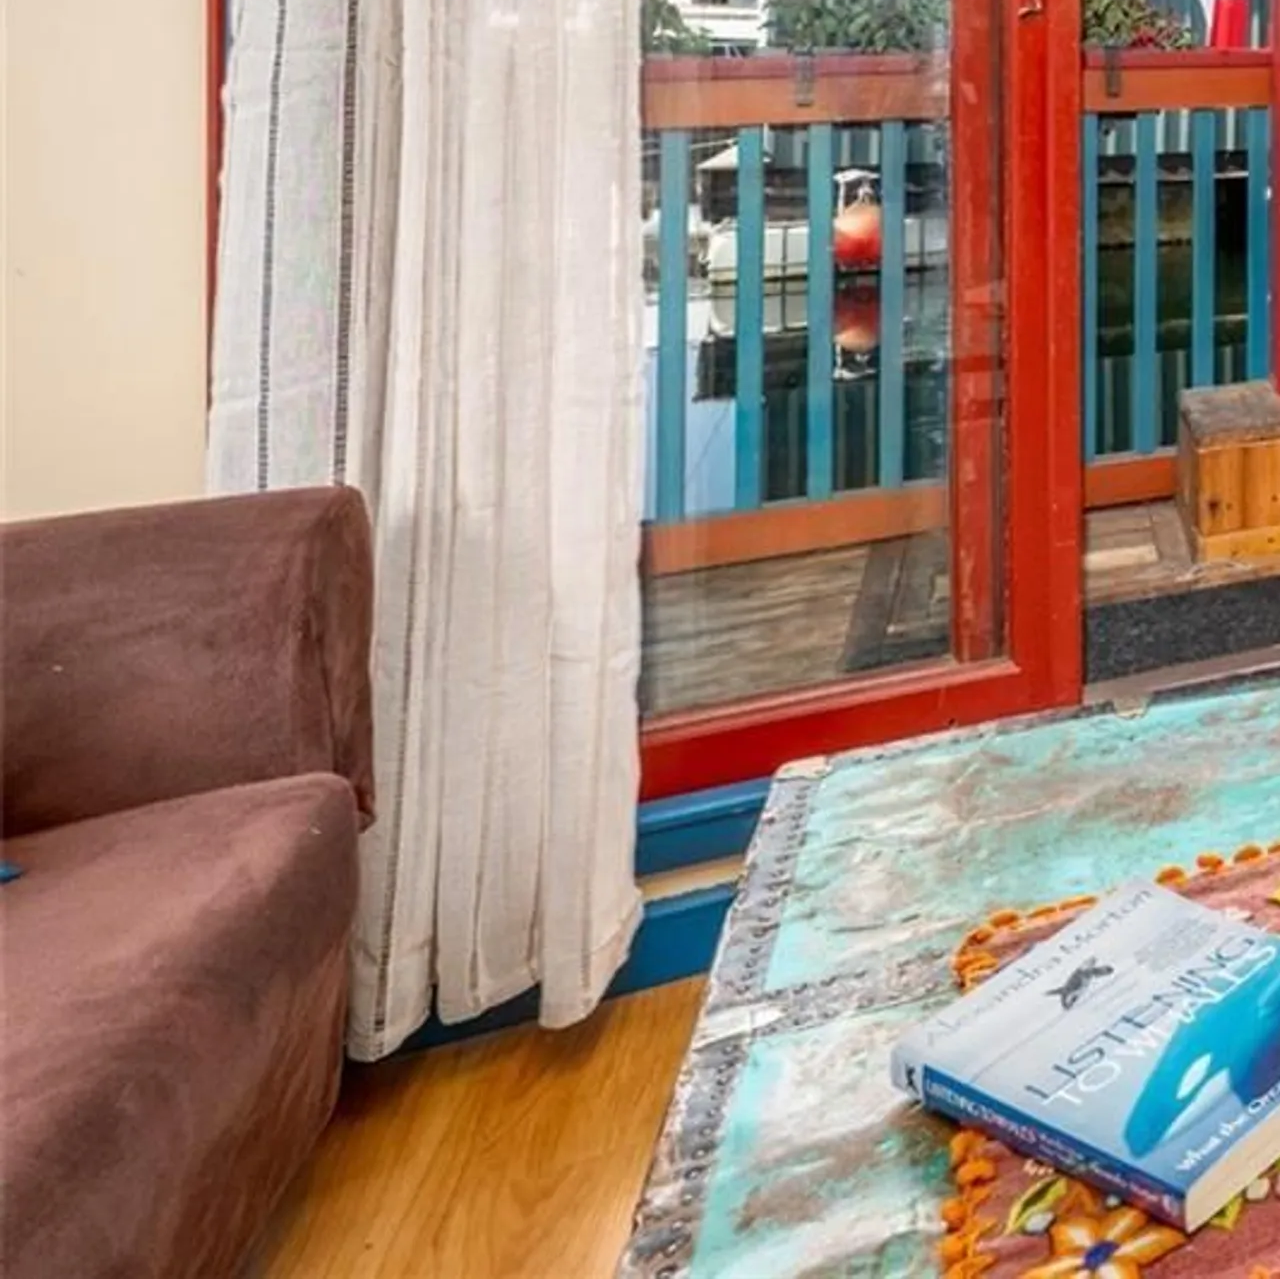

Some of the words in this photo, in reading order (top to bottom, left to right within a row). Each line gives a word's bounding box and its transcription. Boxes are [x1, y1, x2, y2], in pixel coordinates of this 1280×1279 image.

[1059, 889, 1152, 955] Morton
[1024, 933, 1255, 1099] LISTENING
[1040, 1060, 1122, 1106] TO
[1113, 944, 1277, 1058] WHALES
[1175, 1135, 1220, 1171] What
[1219, 1112, 1248, 1137] the
